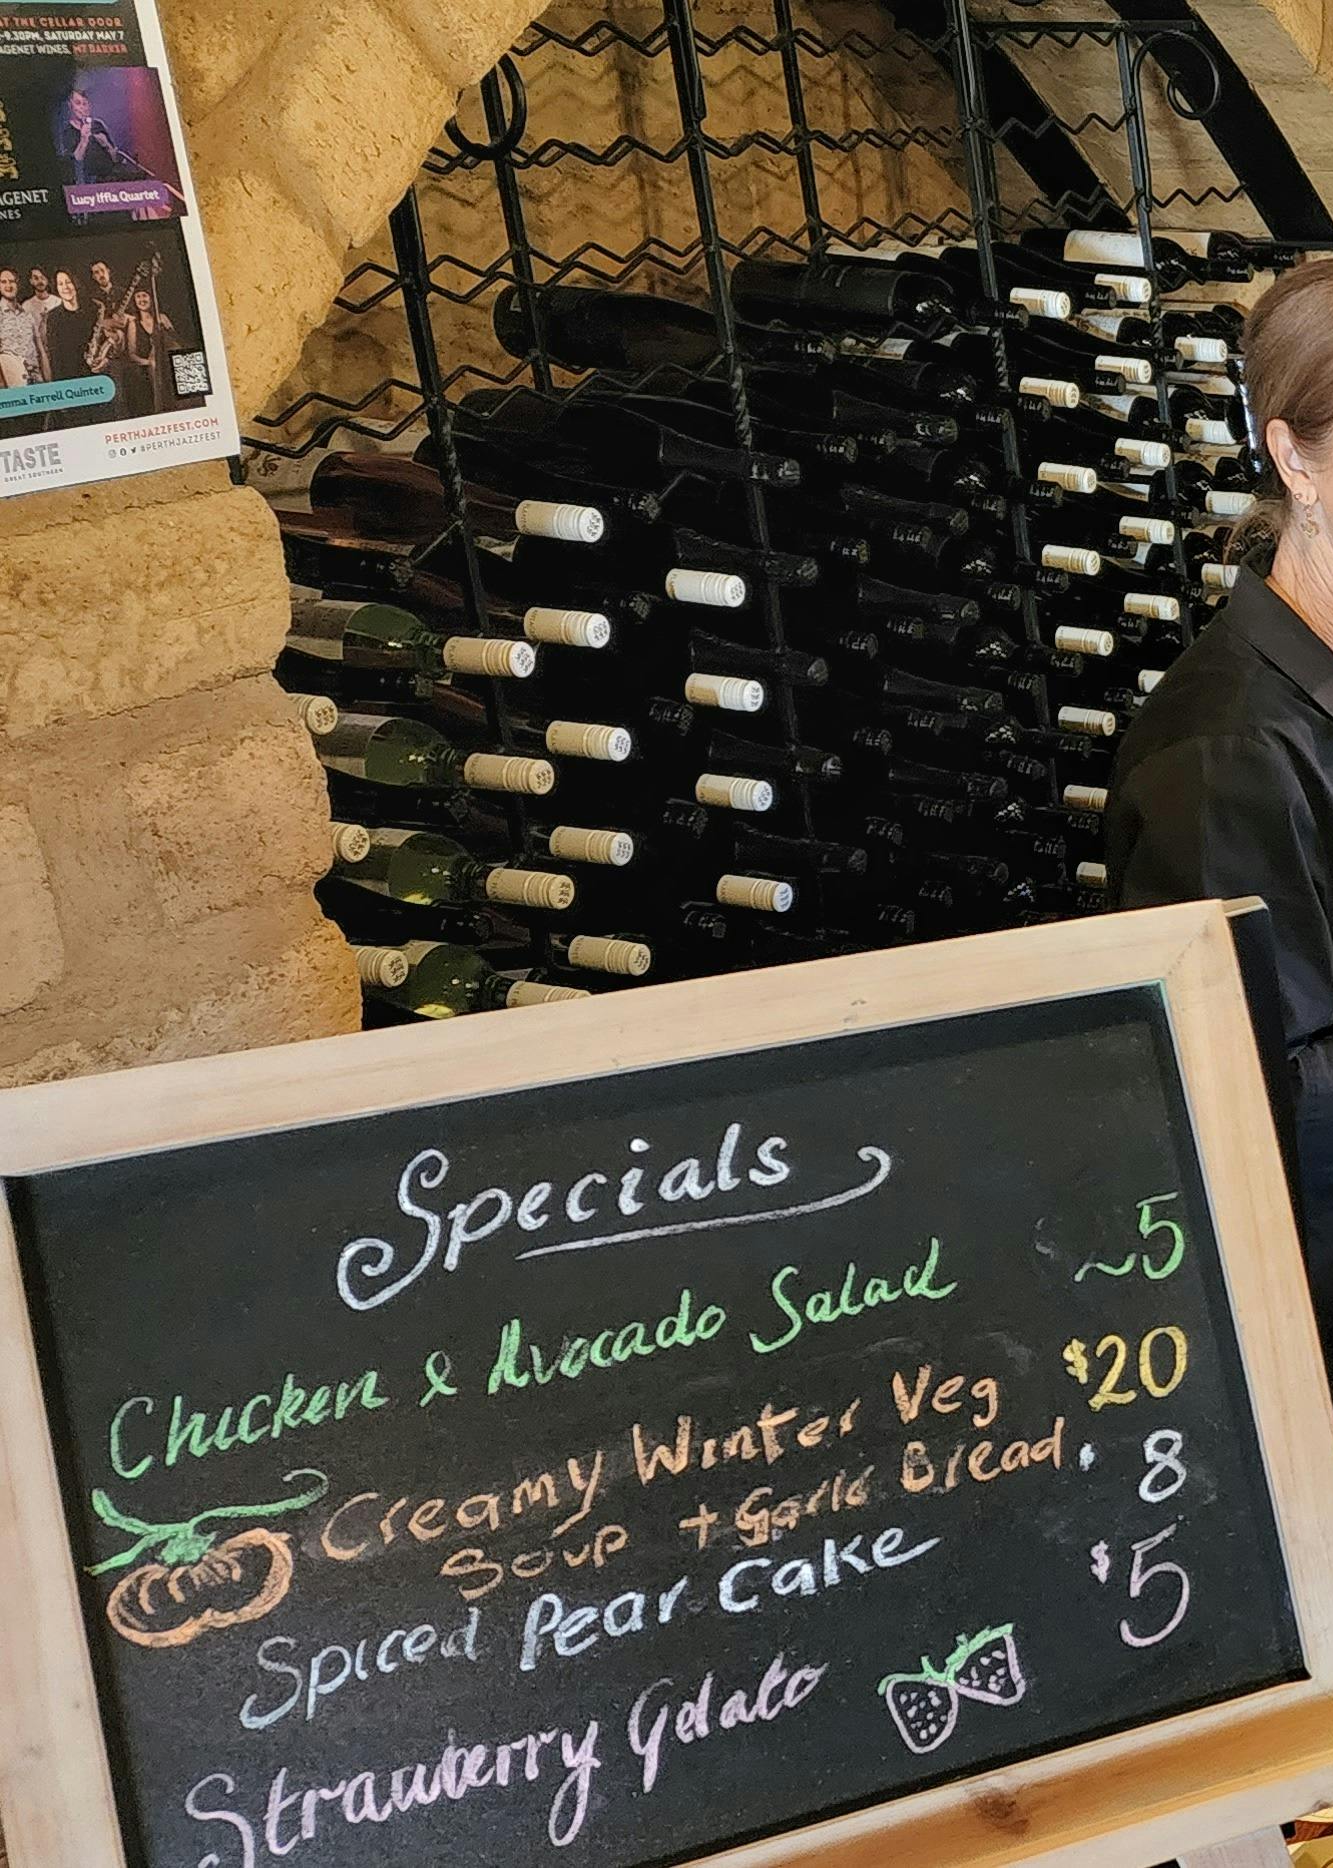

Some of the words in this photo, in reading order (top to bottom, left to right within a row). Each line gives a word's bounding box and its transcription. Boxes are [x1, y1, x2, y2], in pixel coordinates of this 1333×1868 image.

[12, 16, 36, 28] THE
[39, 16, 83, 28] CELLAR
[87, 16, 124, 28] DOOR
[44, 30, 94, 41] SATURDAY
[95, 30, 116, 41] MAY
[116, 30, 125, 41] 7
[88, 43, 129, 54] BARKER
[70, 193, 96, 207] Lucy
[119, 189, 160, 203] Quartet
[29, 389, 64, 405] Farrell
[65, 385, 105, 400] Quintet
[105, 416, 220, 444] PERTHJAZZFEST.COM
[0, 442, 62, 474] TASTE
[28, 468, 64, 480] SOUTHERN
[336, 1122, 793, 1312] Specials
[108, 1364, 391, 1484] Chicken
[486, 1288, 729, 1398] Avocado
[749, 1236, 959, 1356] Salad
[318, 1449, 607, 1562] Creamy
[630, 1397, 861, 1487] Winter
[890, 1364, 1001, 1429] Veg
[1061, 1325, 1190, 1413] $20
[438, 1522, 629, 1601] Soup
[239, 1605, 480, 1733] Spiced
[518, 1576, 691, 1671] Pear
[717, 1521, 941, 1613] Cake
[184, 1719, 602, 1868] Strawberry
[626, 1650, 831, 1795] Gelato
[1088, 1520, 1192, 1649] $5
